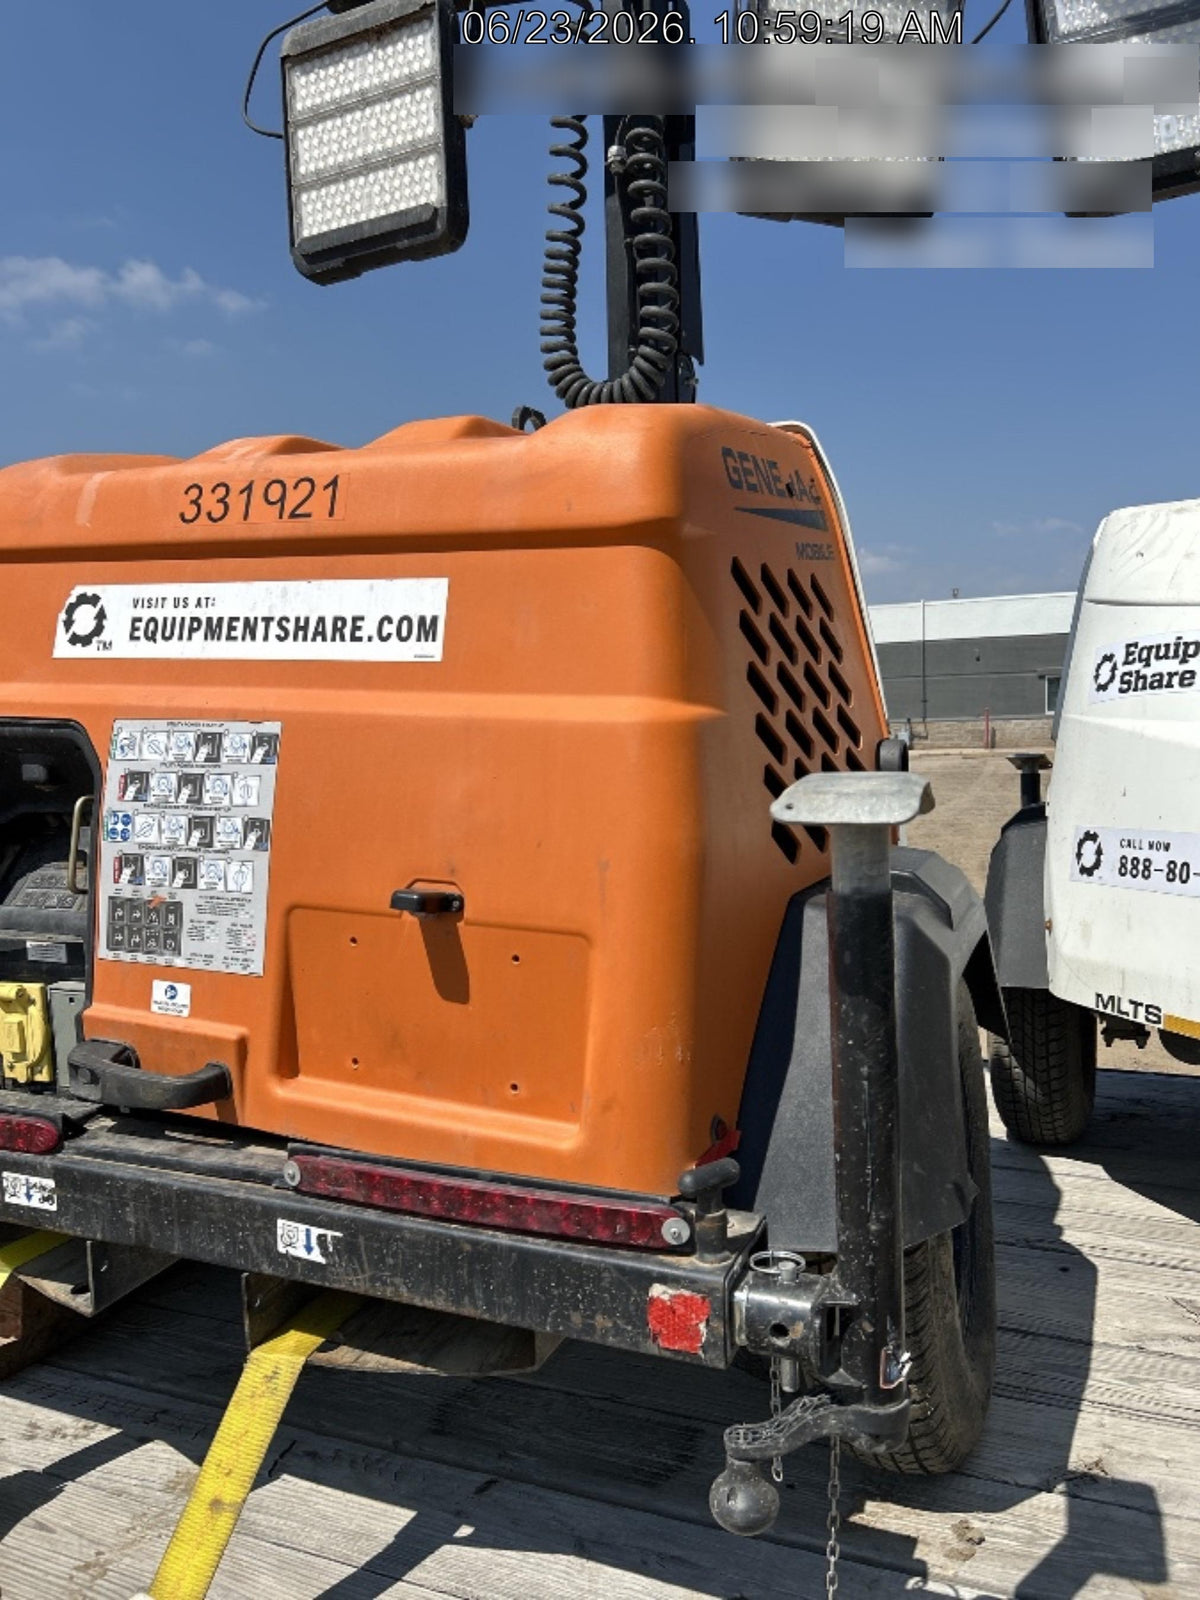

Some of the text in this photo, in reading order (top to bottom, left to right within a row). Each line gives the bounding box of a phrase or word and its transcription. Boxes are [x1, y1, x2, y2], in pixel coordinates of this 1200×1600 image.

[179, 474, 339, 524] 331921
[132, 597, 216, 609] VISIT US AT:
[129, 614, 439, 644] EQUIPMENTSHARE.COM
[1122, 636, 1200, 668] Equip
[1118, 669, 1197, 694] Share
[1120, 838, 1171, 852] CALL NOW
[1094, 992, 1162, 1025] MLTS
